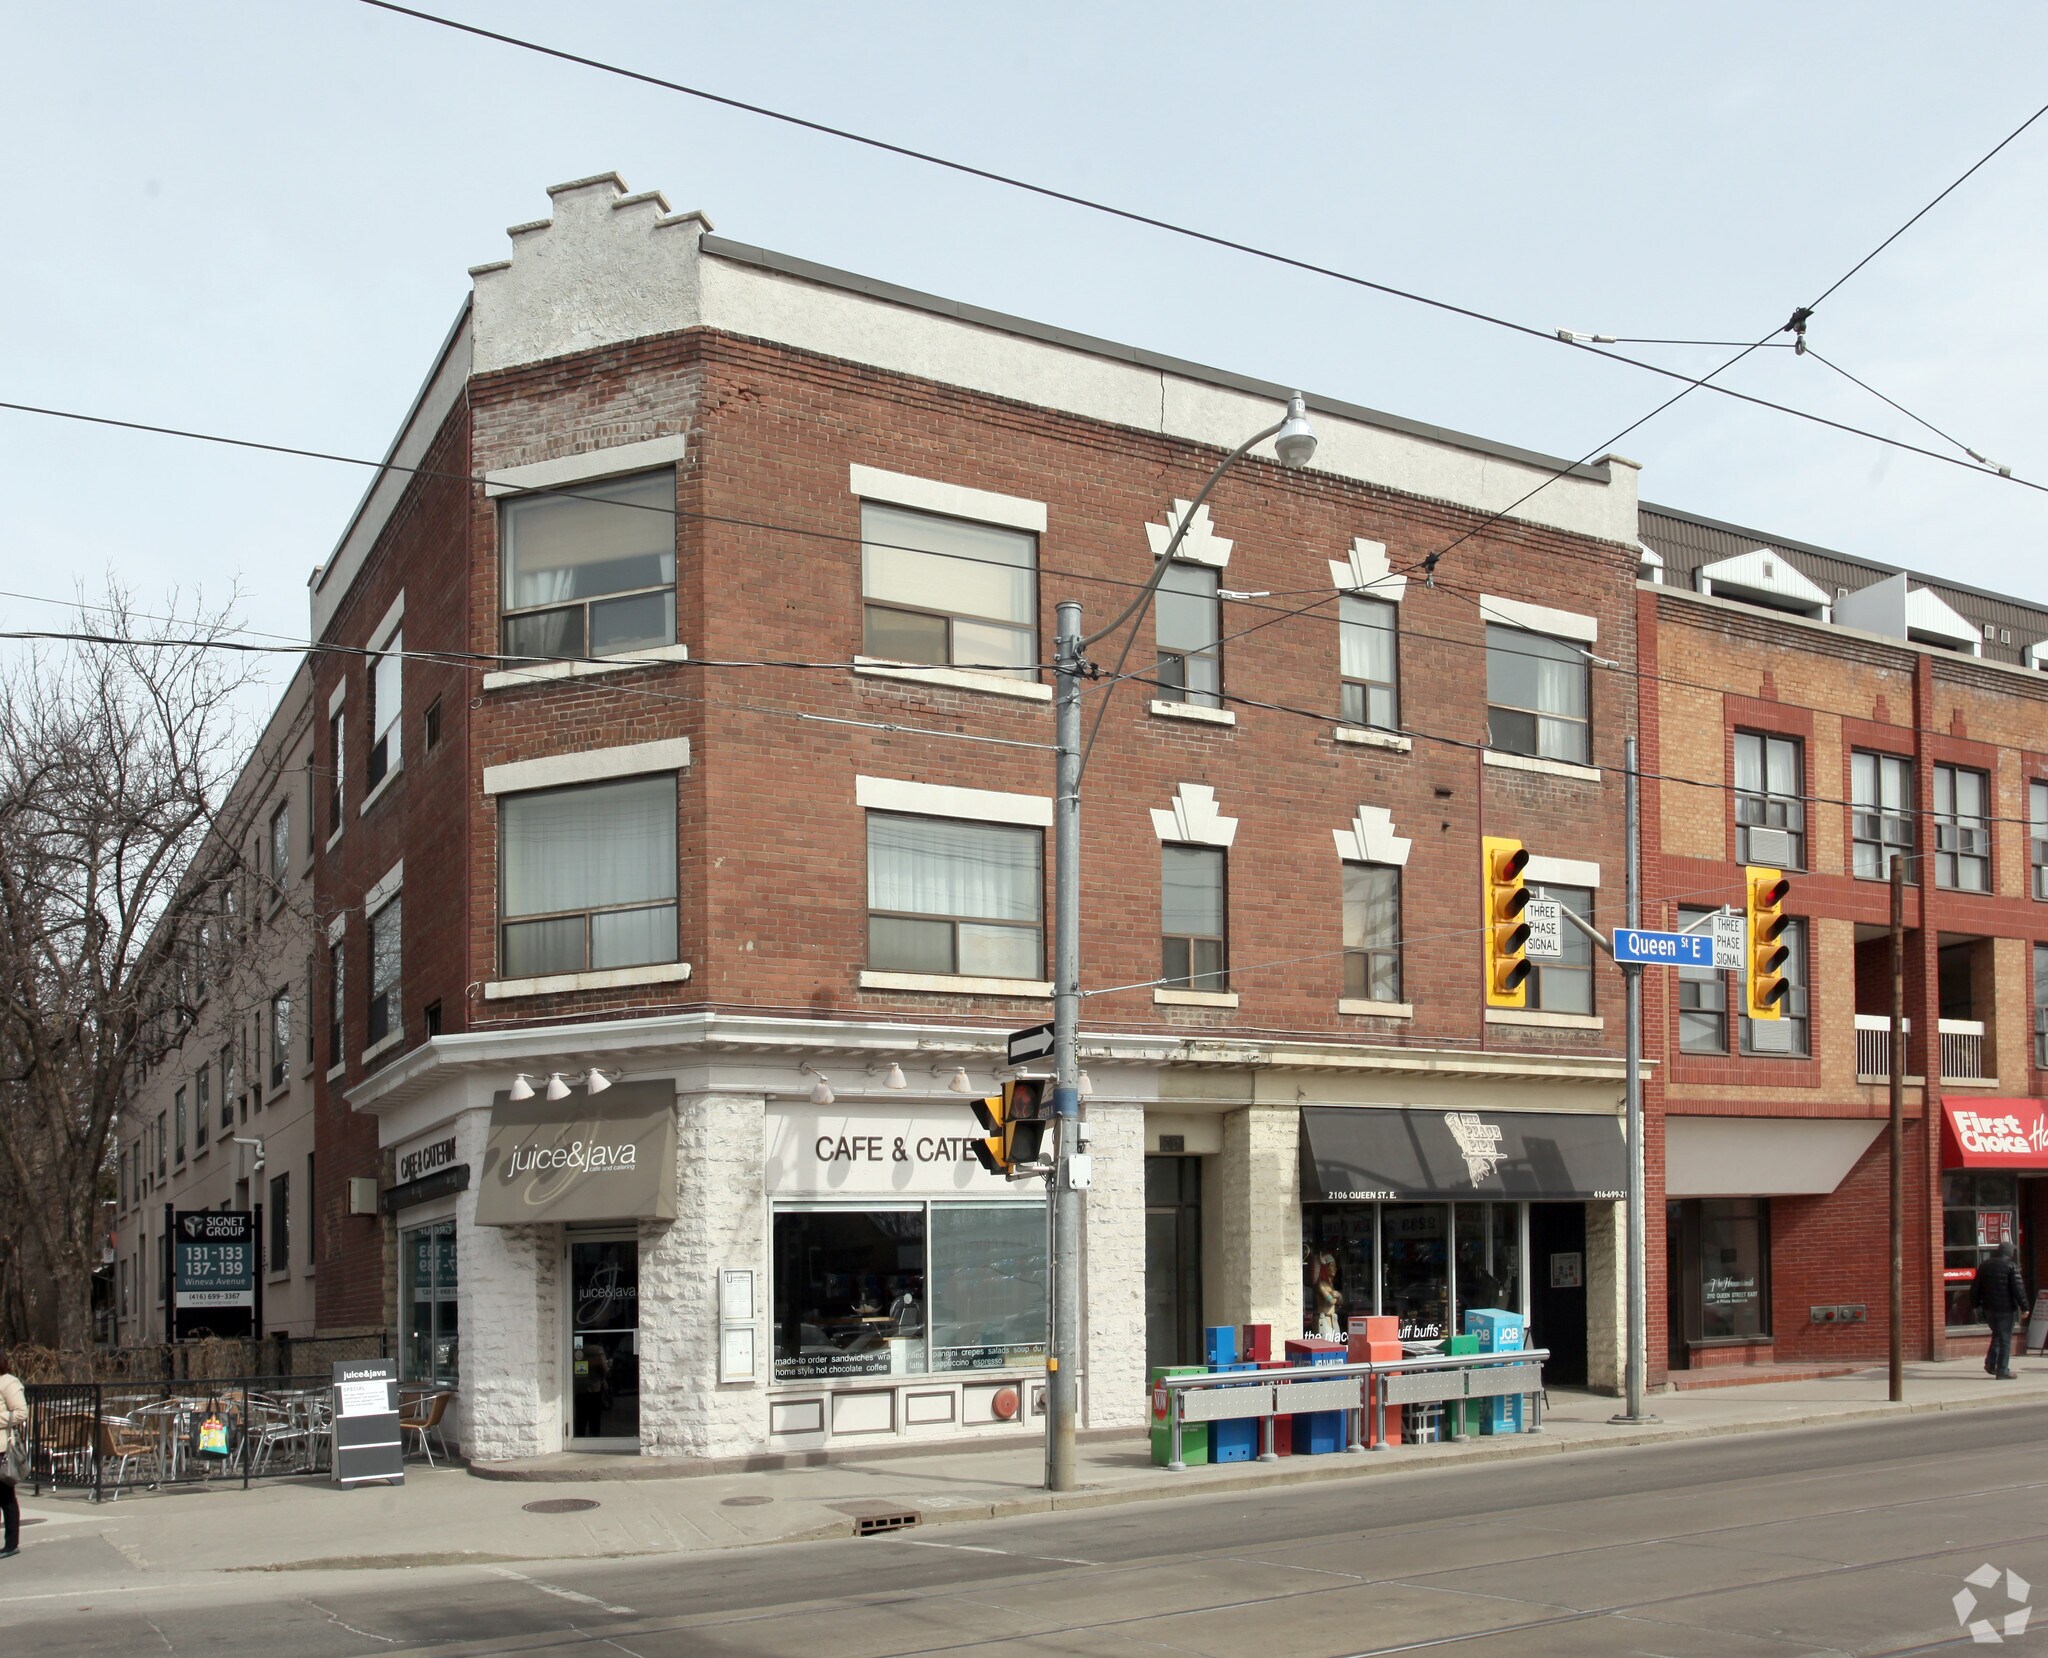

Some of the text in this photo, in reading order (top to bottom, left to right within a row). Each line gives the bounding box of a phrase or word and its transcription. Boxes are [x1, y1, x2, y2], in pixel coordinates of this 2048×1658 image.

[1530, 905, 1556, 918] THREE
[1529, 921, 1557, 934] PHASE
[1717, 918, 1740, 932] THREE
[1528, 938, 1559, 951] SIGNAL
[1628, 932, 1701, 958] Queen St E
[1717, 935, 1740, 950] PHASE
[1716, 952, 1741, 966] SIGNAL
[1952, 1111, 2023, 1134] First
[1464, 1125, 1501, 1139] PEACE
[815, 1136, 981, 1161] CAFE & CATE
[1469, 1140, 1496, 1152] PIPE
[1961, 1130, 2032, 1153] Choice
[401, 1152, 417, 1179] CAFE
[507, 1140, 636, 1177] juice&java
[613, 1163, 635, 1171] catering
[1328, 1191, 1397, 1199] 2106 QUEEN ST. E.
[1593, 1190, 1628, 1198] 416-699-21
[206, 1216, 245, 1226] SIGNET
[206, 1227, 245, 1236] GROUP
[215, 1277, 246, 1285] Avenue
[207, 1292, 240, 1300] 699-3367
[579, 1285, 636, 1301] juice&java
[1325, 1329, 1349, 1345] plac
[1398, 1324, 1412, 1338] uff
[1499, 1328, 1519, 1340] JOB
[775, 1357, 806, 1365] made-to
[807, 1355, 828, 1364] order
[831, 1353, 873, 1362] sandwiches
[961, 1348, 984, 1357] crepes
[987, 1346, 1009, 1354] salads
[775, 1367, 796, 1376] home
[797, 1366, 814, 1376] style
[816, 1365, 828, 1374] hot
[828, 1364, 863, 1374] chocolate
[866, 1363, 888, 1372] coffee
[909, 1361, 924, 1369] latte
[932, 1358, 970, 1369] cappuccino
[972, 1357, 1003, 1366] espresso
[343, 1369, 387, 1381] juice&java
